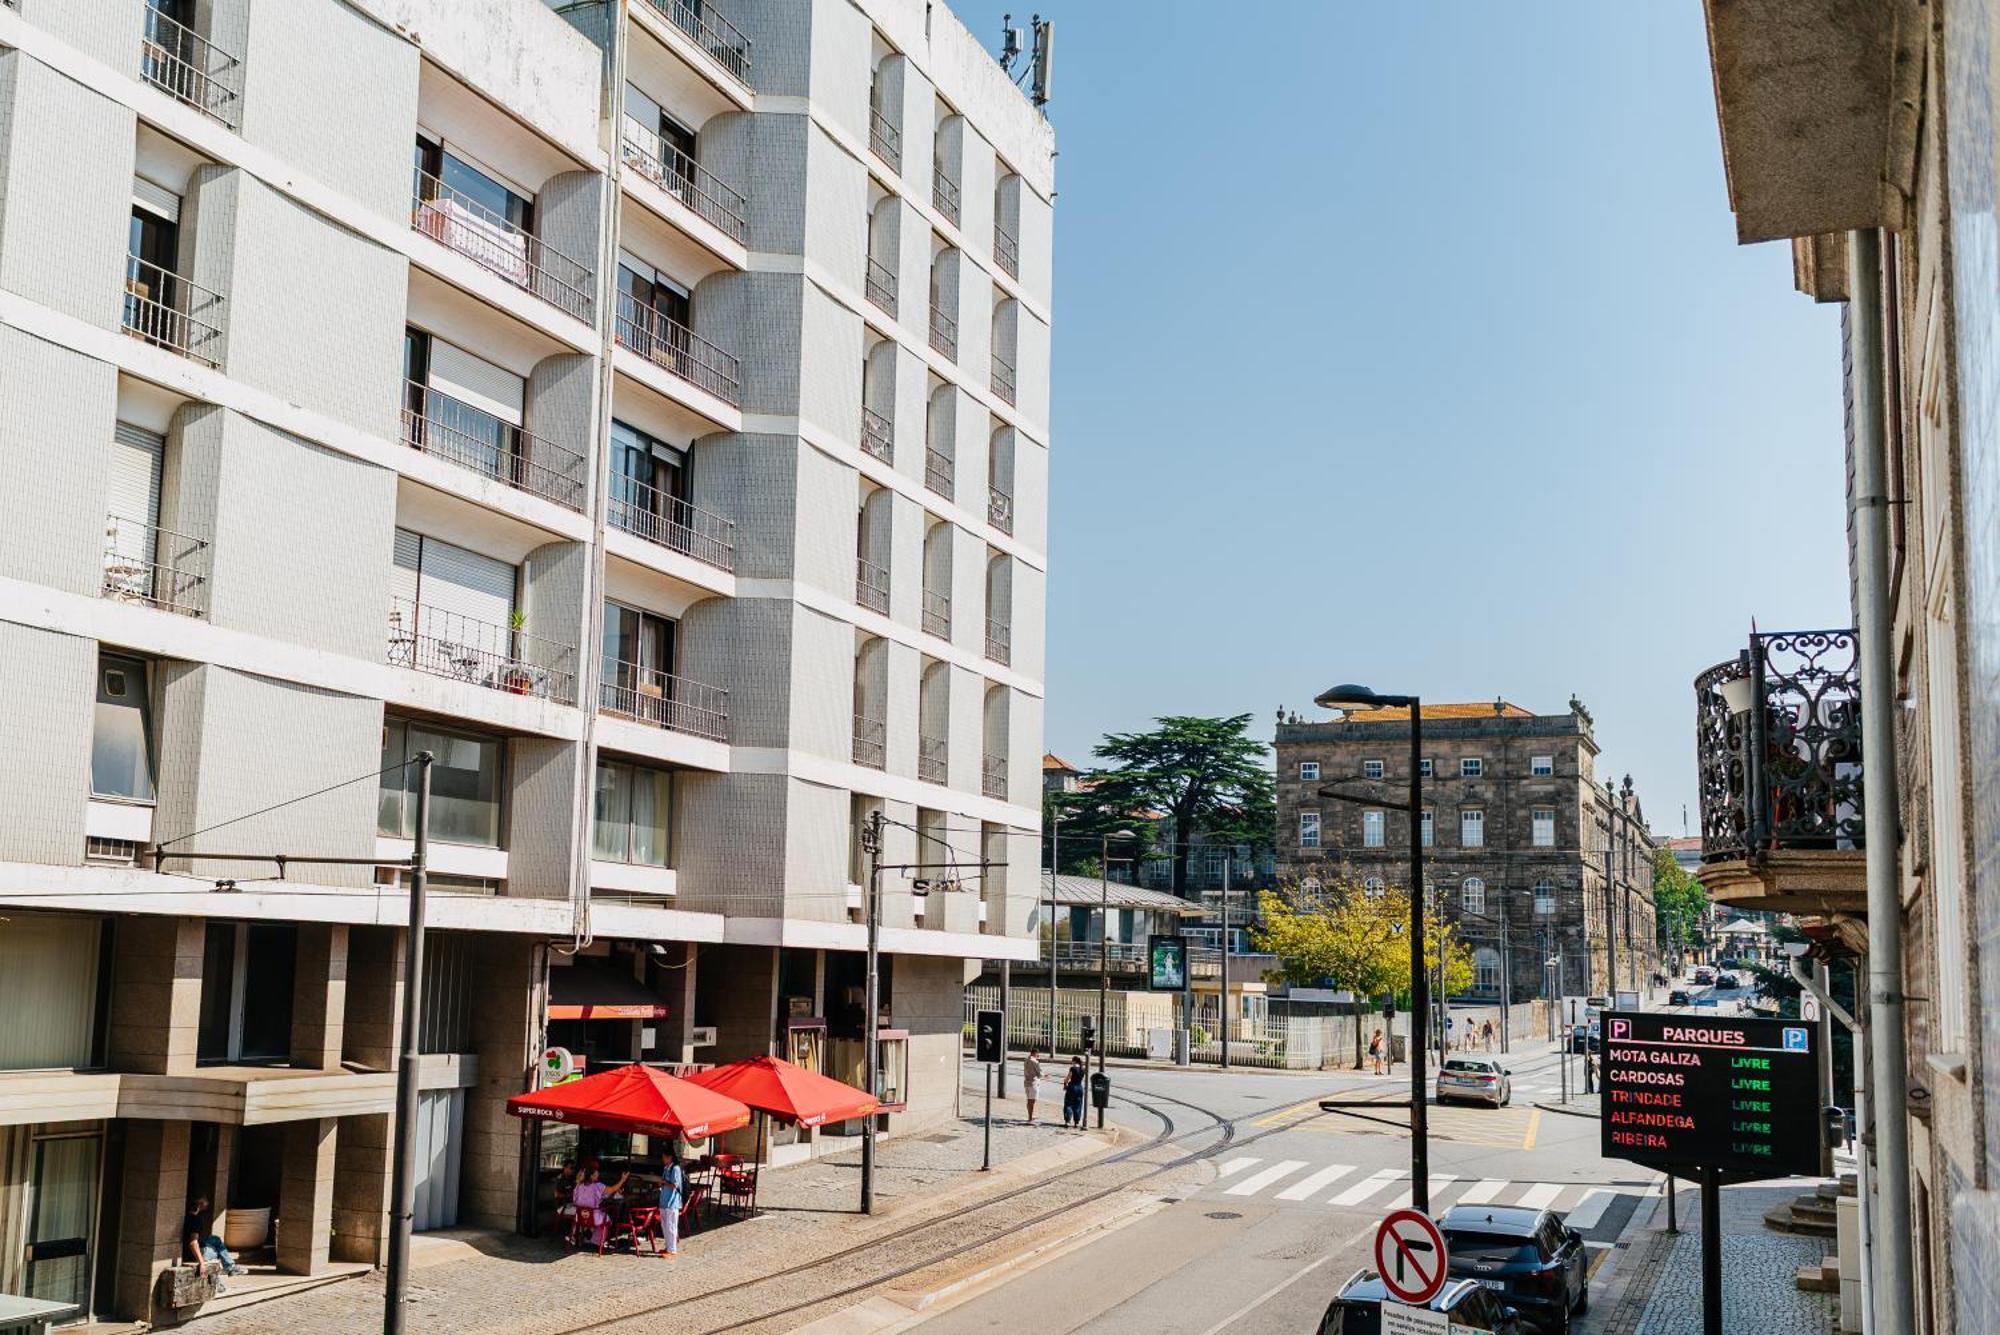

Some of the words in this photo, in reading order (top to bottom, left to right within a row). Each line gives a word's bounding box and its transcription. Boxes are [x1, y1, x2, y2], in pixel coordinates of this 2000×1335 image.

[1613, 1021, 1627, 1038] P
[1663, 1027, 1746, 1045] PARQUES
[1788, 1030, 1802, 1048] P
[1609, 1049, 1647, 1063] MOTA
[1650, 1051, 1701, 1066] GALIZA
[1731, 1057, 1771, 1070] LIVRE
[1610, 1069, 1685, 1086] CARDOSAS
[1731, 1078, 1771, 1091] LIVRE
[1610, 1090, 1682, 1107] TRINDADE
[1732, 1100, 1771, 1112] LIVRE
[517, 1106, 537, 1115] SUPER
[537, 1108, 554, 1117] BOCK
[1611, 1111, 1696, 1129] ALFANDEGA
[1732, 1121, 1771, 1134] LIVRE
[1612, 1131, 1668, 1148] RIBEIRA
[1732, 1143, 1772, 1155] LIVRE
